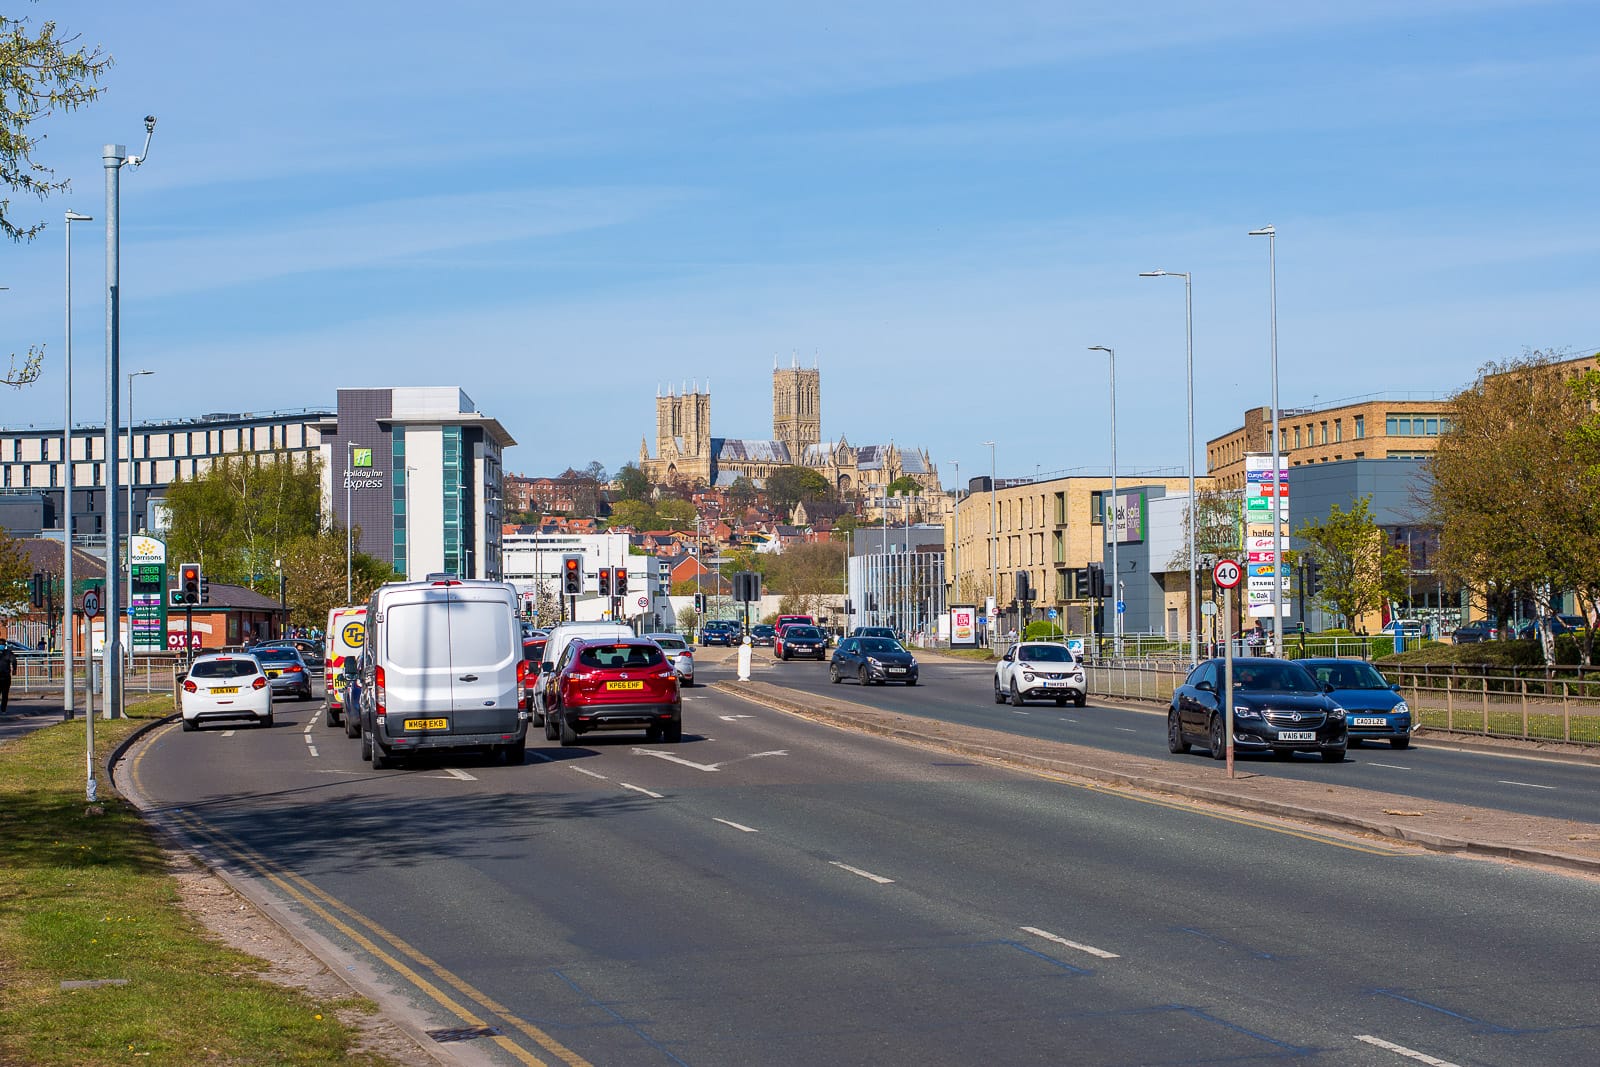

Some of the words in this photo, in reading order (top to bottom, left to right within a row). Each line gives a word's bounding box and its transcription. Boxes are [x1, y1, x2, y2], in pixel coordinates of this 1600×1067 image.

[344, 469, 371, 478] Holiday
[371, 469, 383, 477] Inn
[344, 478, 383, 490] Express
[1218, 567, 1238, 580] 40
[85, 598, 98, 610] 40
[429, 719, 444, 728] EKB
[1283, 732, 1298, 740] VA16
[1299, 732, 1312, 740] WUR
